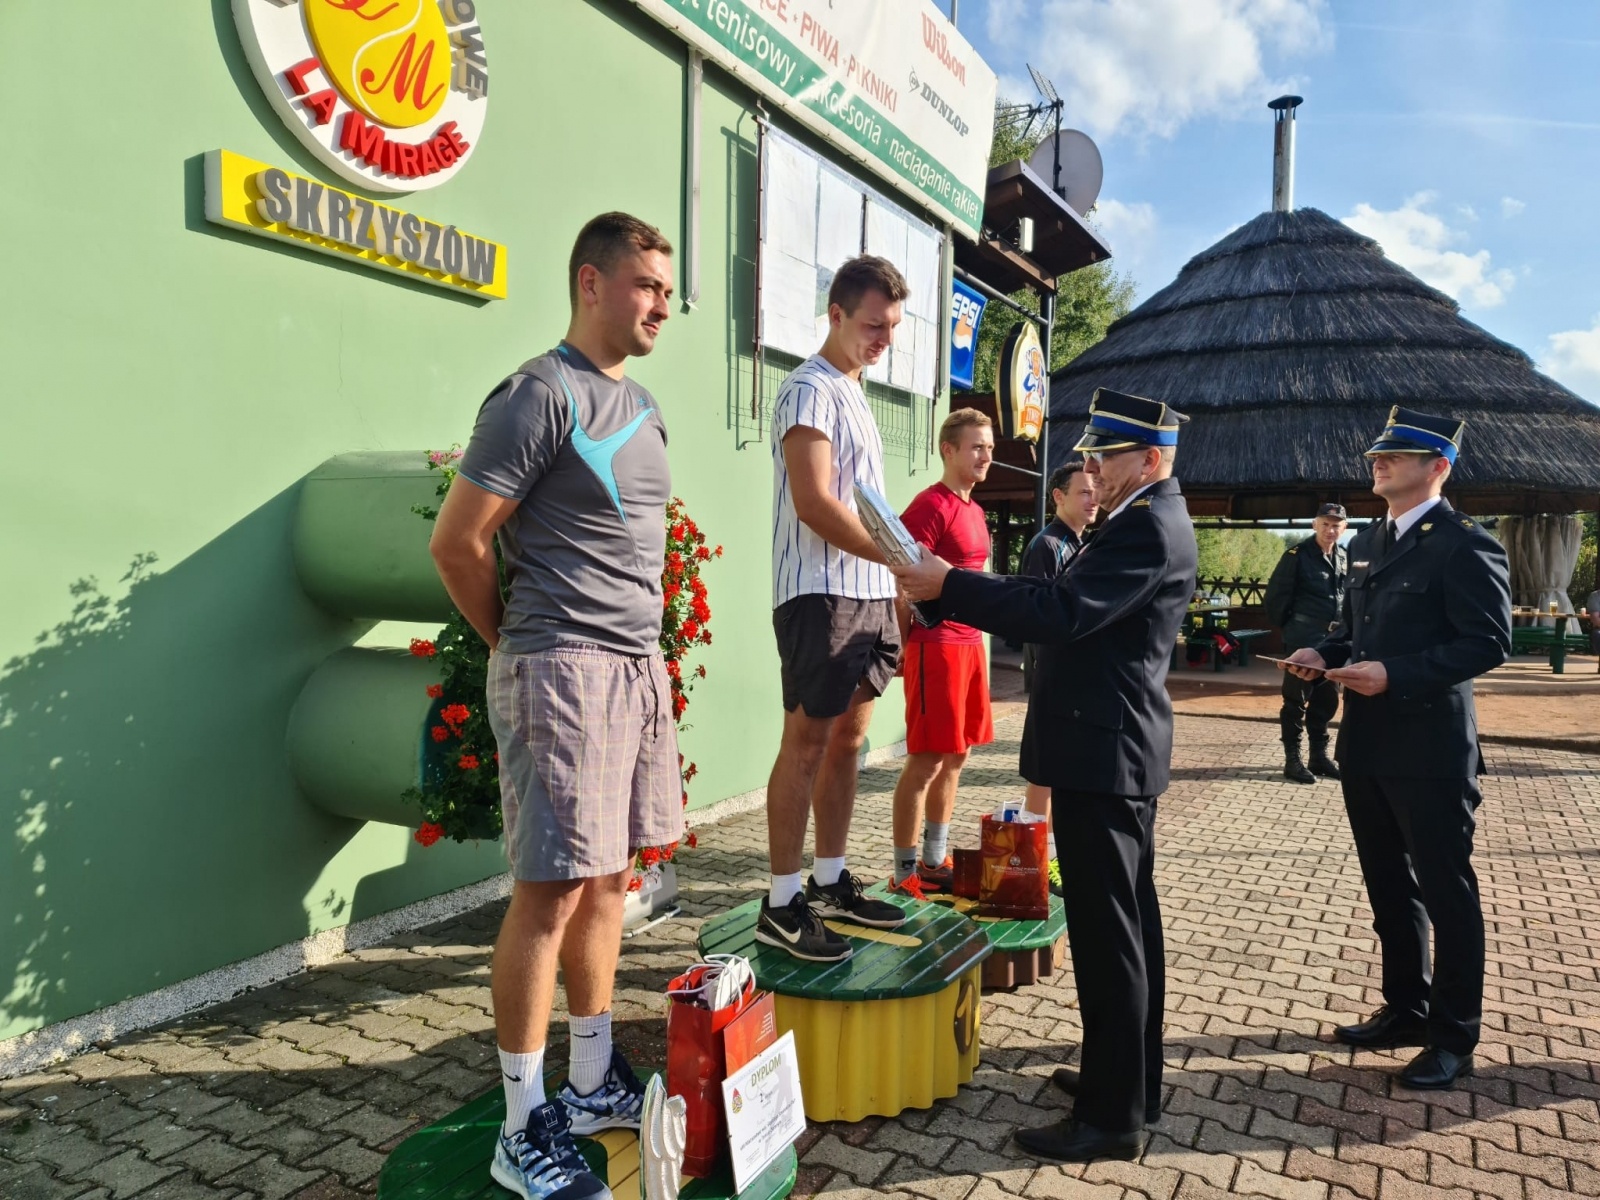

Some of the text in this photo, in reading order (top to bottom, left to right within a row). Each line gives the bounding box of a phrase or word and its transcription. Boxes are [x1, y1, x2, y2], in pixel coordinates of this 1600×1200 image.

[360, 32, 445, 110] M
[759, 0, 898, 113] CE PIWA PIKNIKI
[921, 11, 966, 87] Wilson
[284, 57, 470, 178] LA MIRAGE
[706, 0, 797, 88] tenisowy
[889, 138, 951, 196] naciąganie
[951, 184, 979, 222] rakiet
[920, 82, 969, 137] DUNLOP
[262, 168, 497, 285] SKRZYSZÓW
[751, 1053, 782, 1087] DYPLOM
